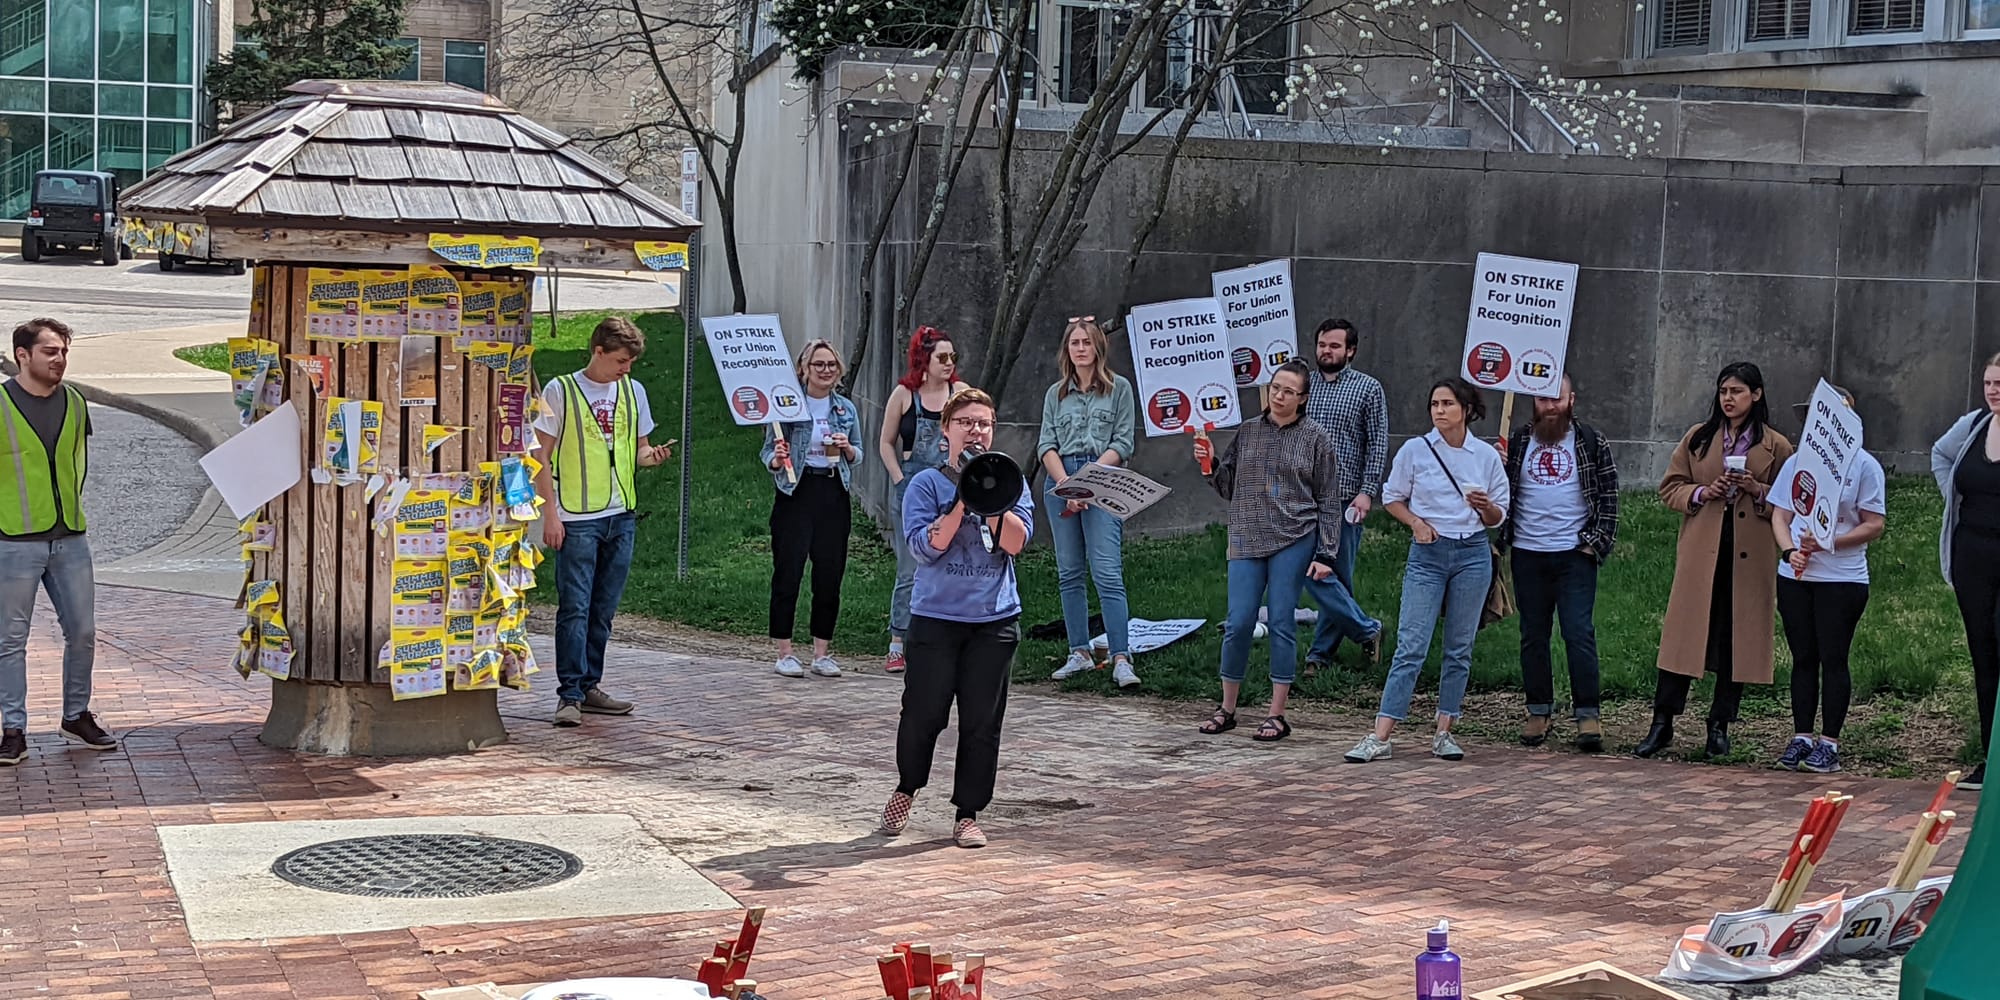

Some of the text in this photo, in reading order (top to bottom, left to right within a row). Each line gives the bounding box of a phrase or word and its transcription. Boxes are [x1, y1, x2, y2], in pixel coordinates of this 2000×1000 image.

[486, 247, 534, 257] SUMMER
[484, 255, 534, 265] STORAGE
[313, 281, 359, 292] SUMMER
[363, 281, 408, 294] SUMME
[1222, 275, 1283, 296] ON STRIKE
[1484, 271, 1564, 291] ON STRIKE
[310, 289, 360, 301] STORAGE
[362, 290, 408, 302] STORAG
[463, 291, 494, 304] UMMER
[1488, 290, 1556, 309] For Union
[463, 300, 495, 312] TORAGE
[1228, 294, 1281, 312] For Union
[1142, 313, 1217, 332] ON STRIKE
[1226, 309, 1288, 329] Recognition
[1477, 306, 1562, 328] Recognition
[714, 328, 776, 340] ON STRIKE
[1150, 332, 1215, 350] For Union
[723, 342, 776, 354] For Union
[721, 357, 787, 370] Recognition
[1144, 349, 1224, 368] Recognition
[1522, 361, 1551, 378] UE
[774, 395, 798, 407] UE
[1201, 396, 1228, 411] UE
[1816, 400, 1855, 450] ON STRIKE
[1814, 420, 1844, 463] For Union
[1806, 433, 1842, 486] Recognition
[1110, 474, 1156, 494] STRIKE
[1110, 478, 1144, 496] Union
[400, 500, 447, 513] SUMMER
[397, 509, 447, 523] STORAGE
[396, 571, 442, 583] SUMMER
[393, 579, 443, 593] STORAGE
[395, 640, 442, 653] SUMMER
[393, 649, 443, 663] STORAGE
